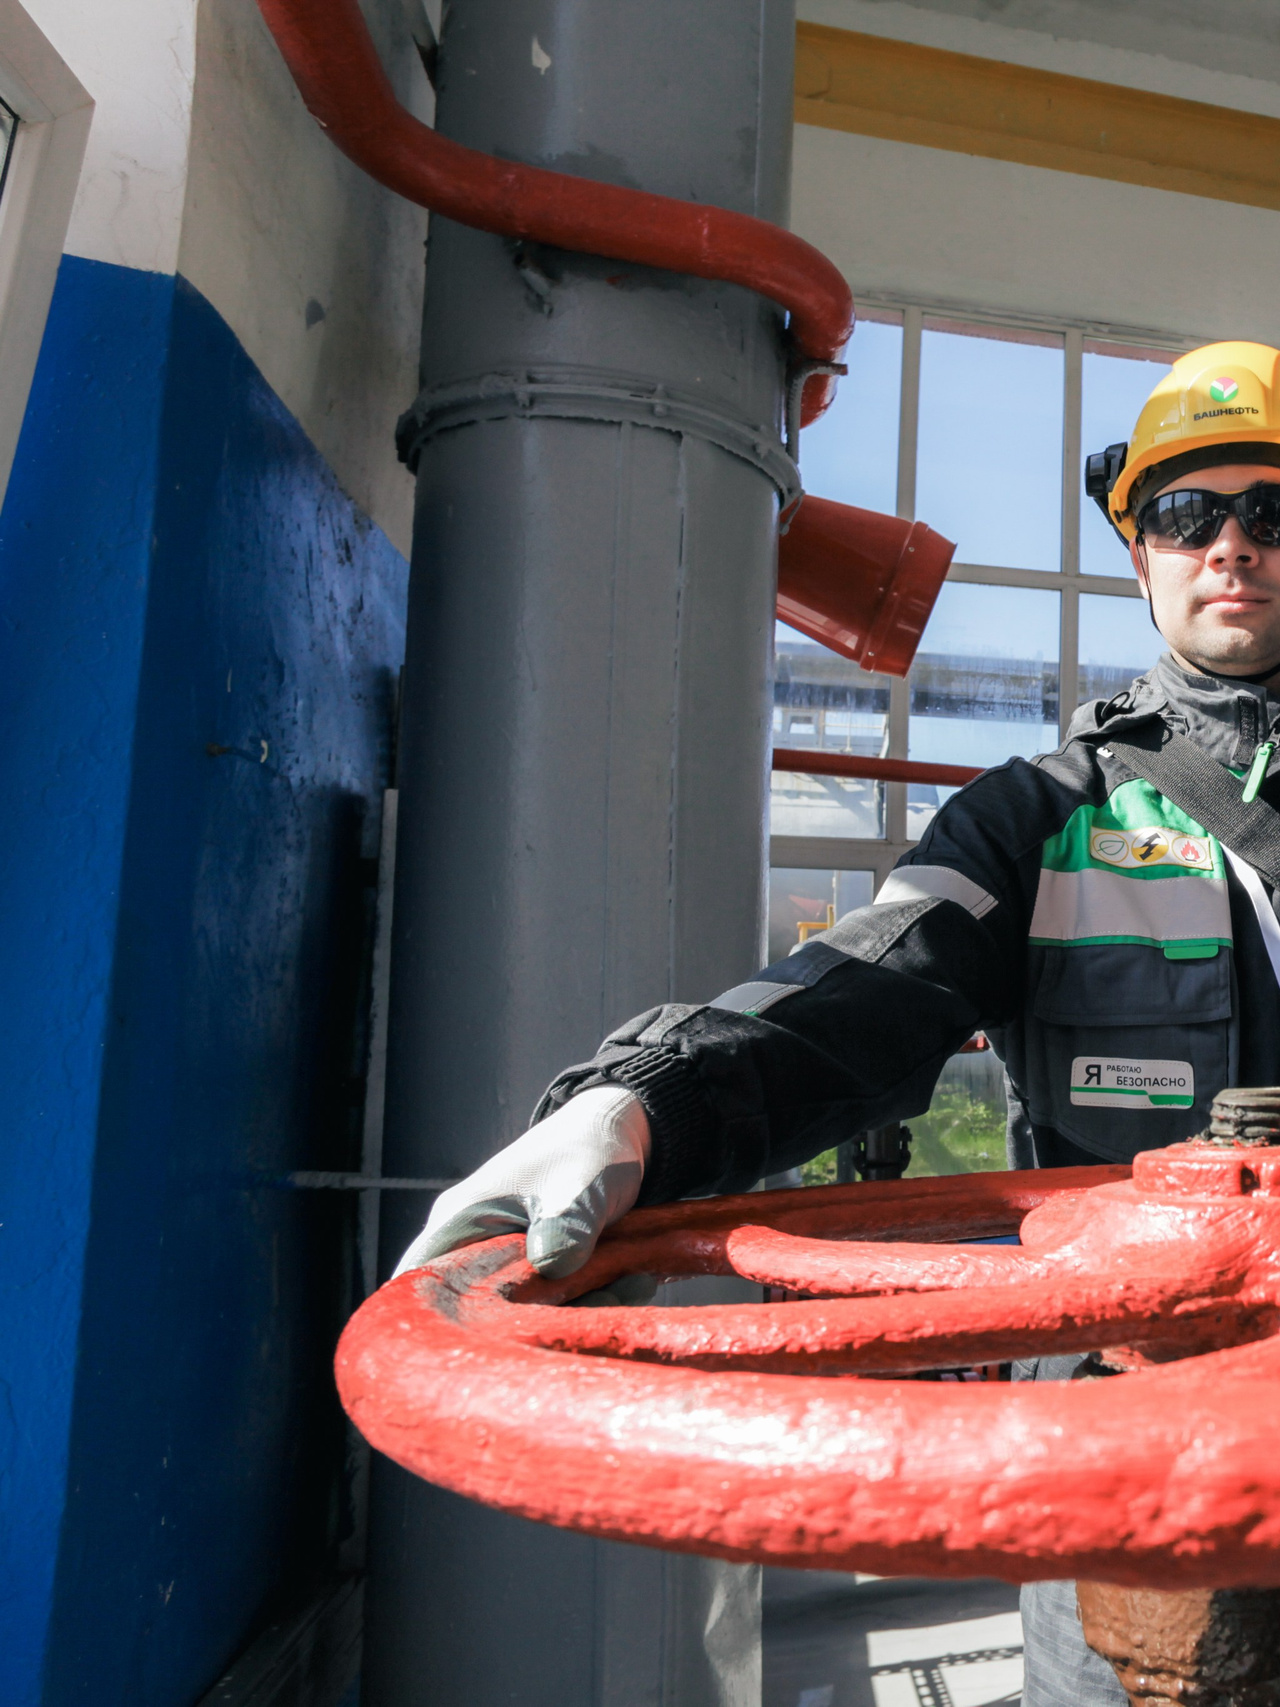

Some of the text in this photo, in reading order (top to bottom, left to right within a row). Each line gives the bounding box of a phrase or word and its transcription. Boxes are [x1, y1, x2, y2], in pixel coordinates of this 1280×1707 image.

[1193, 406, 1260, 421] БАШНЕФТЬ
[1083, 1063, 1142, 1086] Я РАБОТАЮ
[1116, 1075, 1186, 1088] БЕЗОПАСНО
